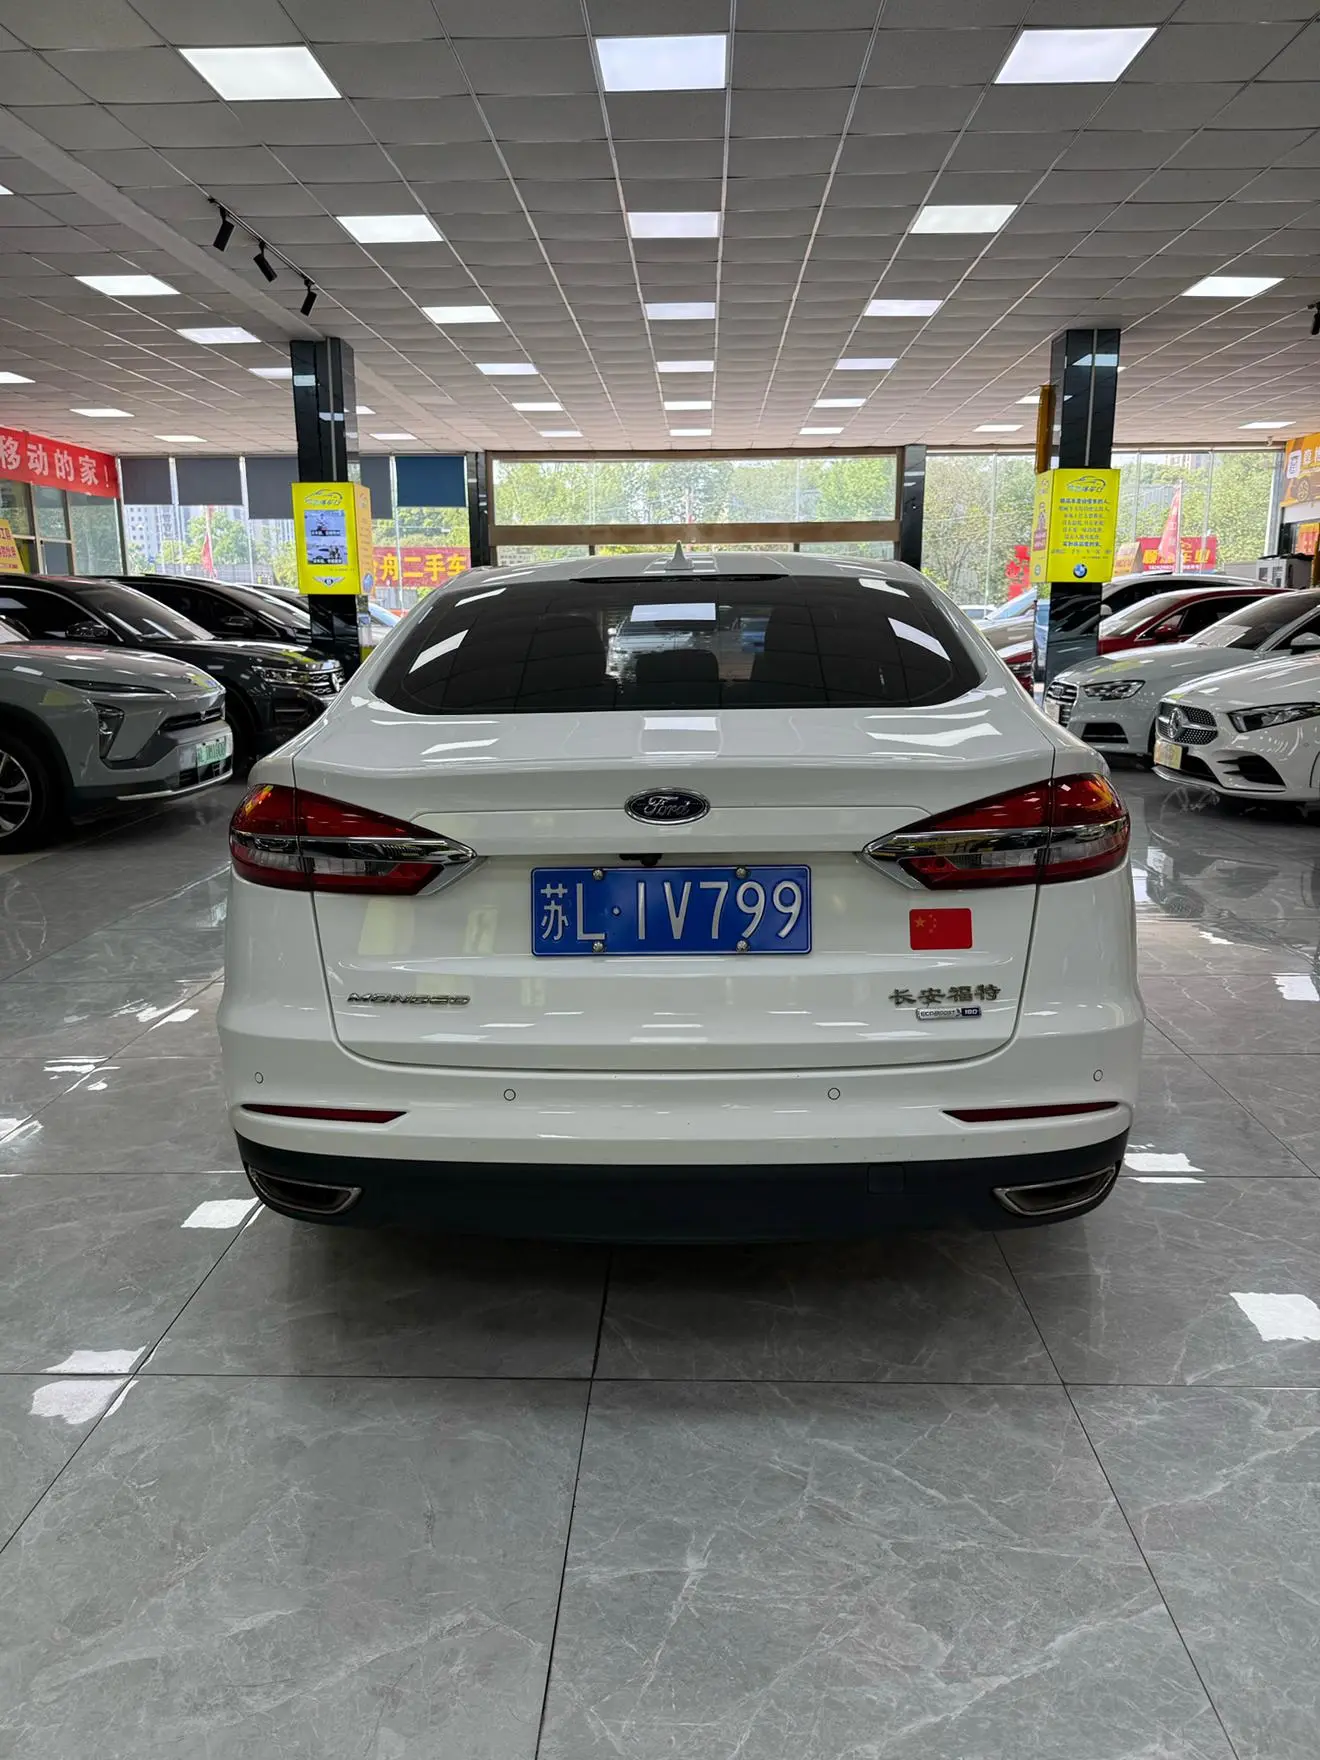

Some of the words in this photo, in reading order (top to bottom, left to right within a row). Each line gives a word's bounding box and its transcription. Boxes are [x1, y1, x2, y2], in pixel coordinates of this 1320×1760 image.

[373, 552, 466, 581] 舟二手车
[644, 796, 690, 816] Ford
[888, 984, 1001, 1007] 长安福特
